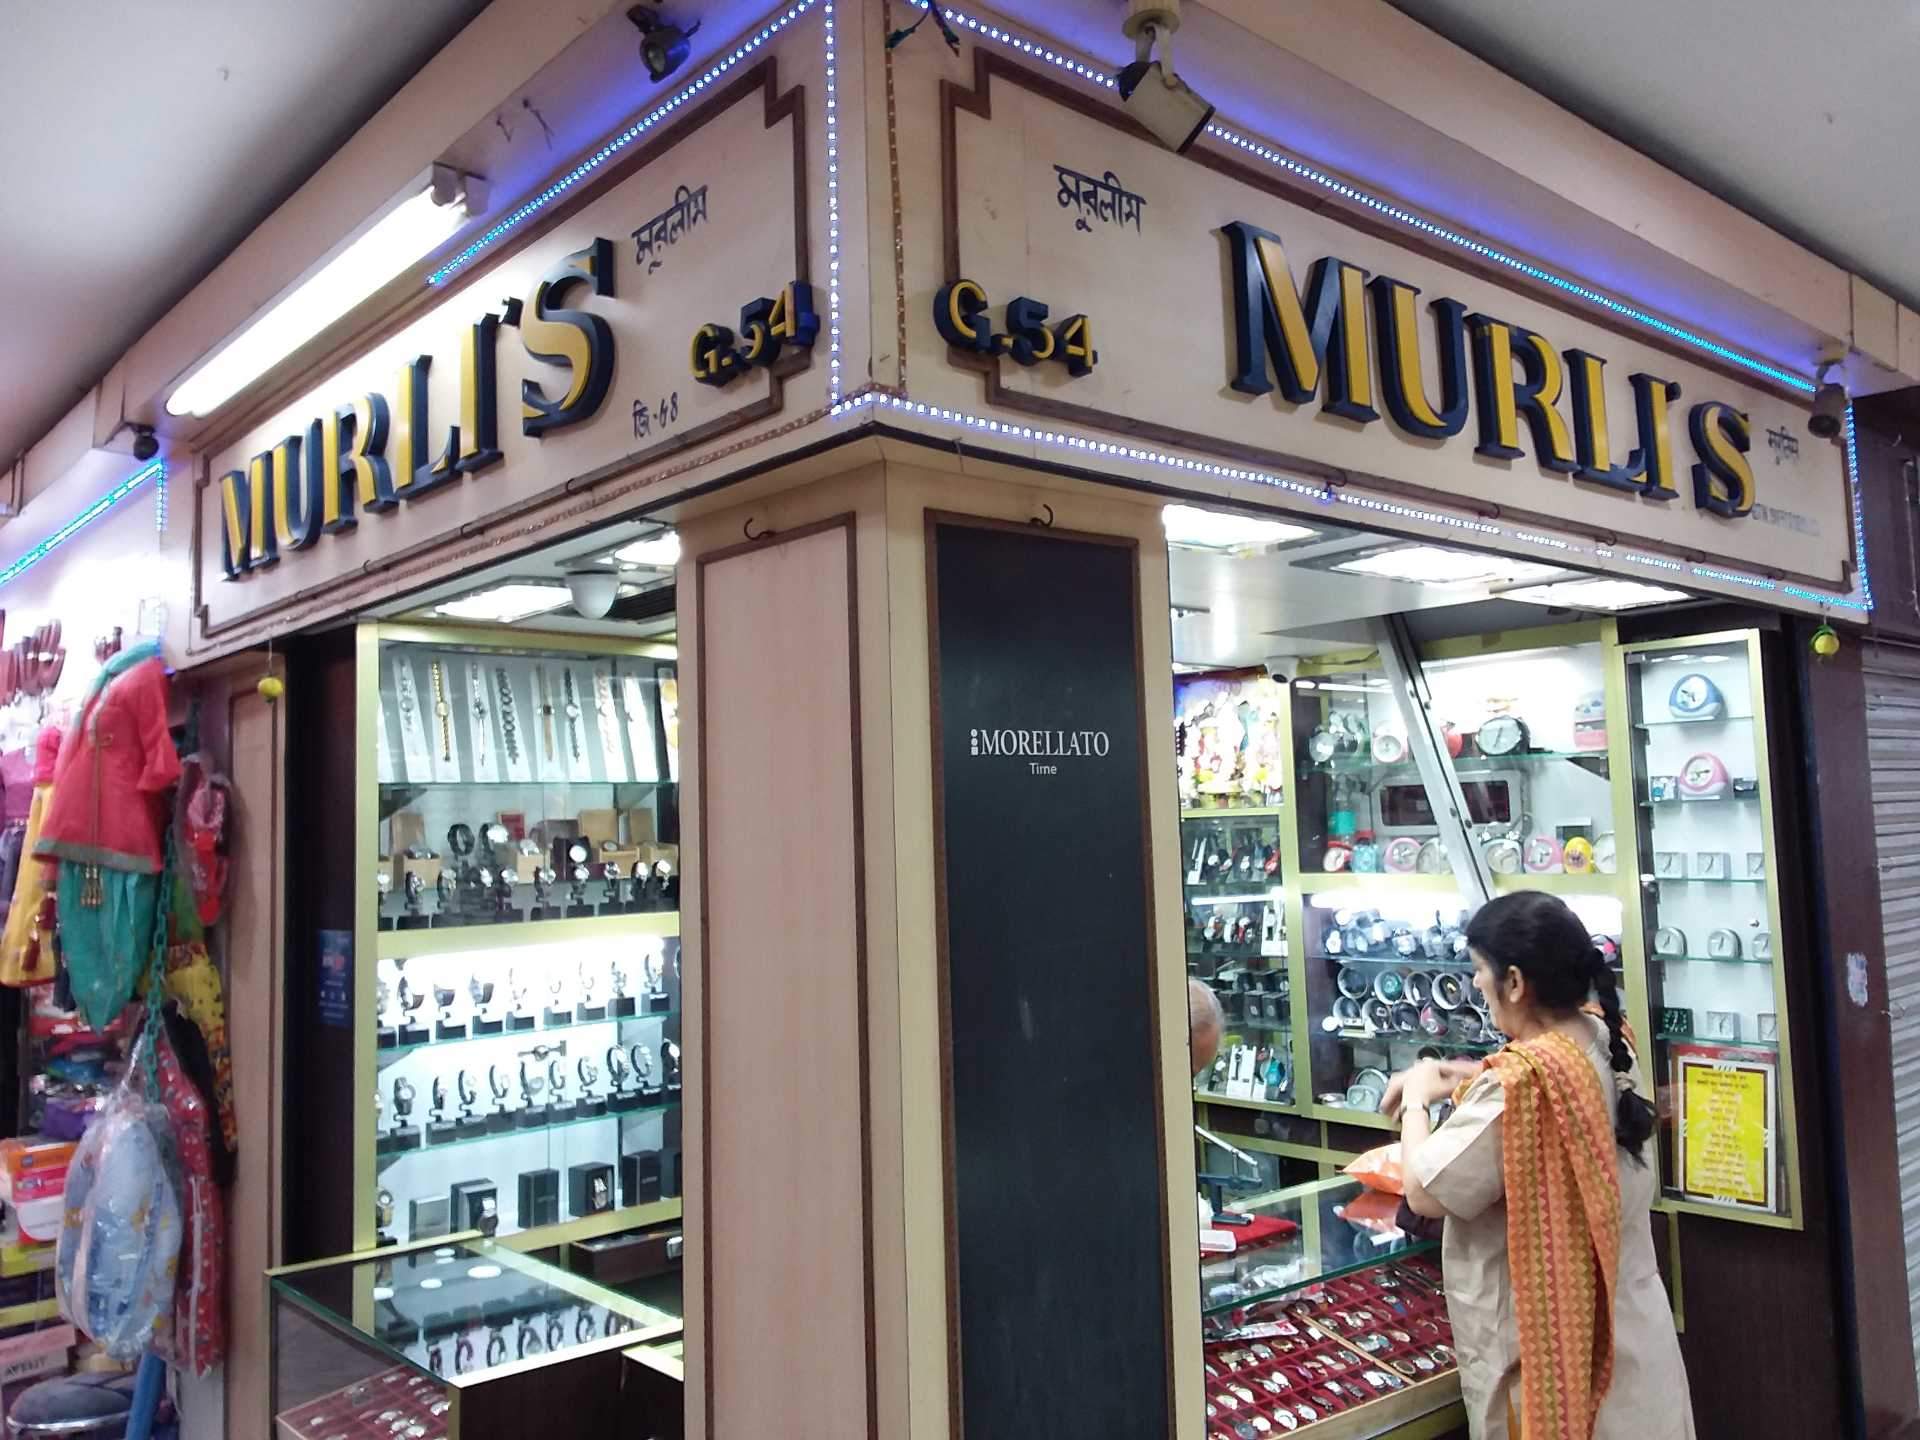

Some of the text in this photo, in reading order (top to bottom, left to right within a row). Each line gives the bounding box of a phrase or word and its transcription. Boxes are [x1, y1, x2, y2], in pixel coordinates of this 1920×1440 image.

[221, 236, 615, 581] MURLI'S
[1221, 221, 1756, 518] MURLI'S
[980, 729, 1110, 757] MORELLATO
[1028, 762, 1058, 775] Time
